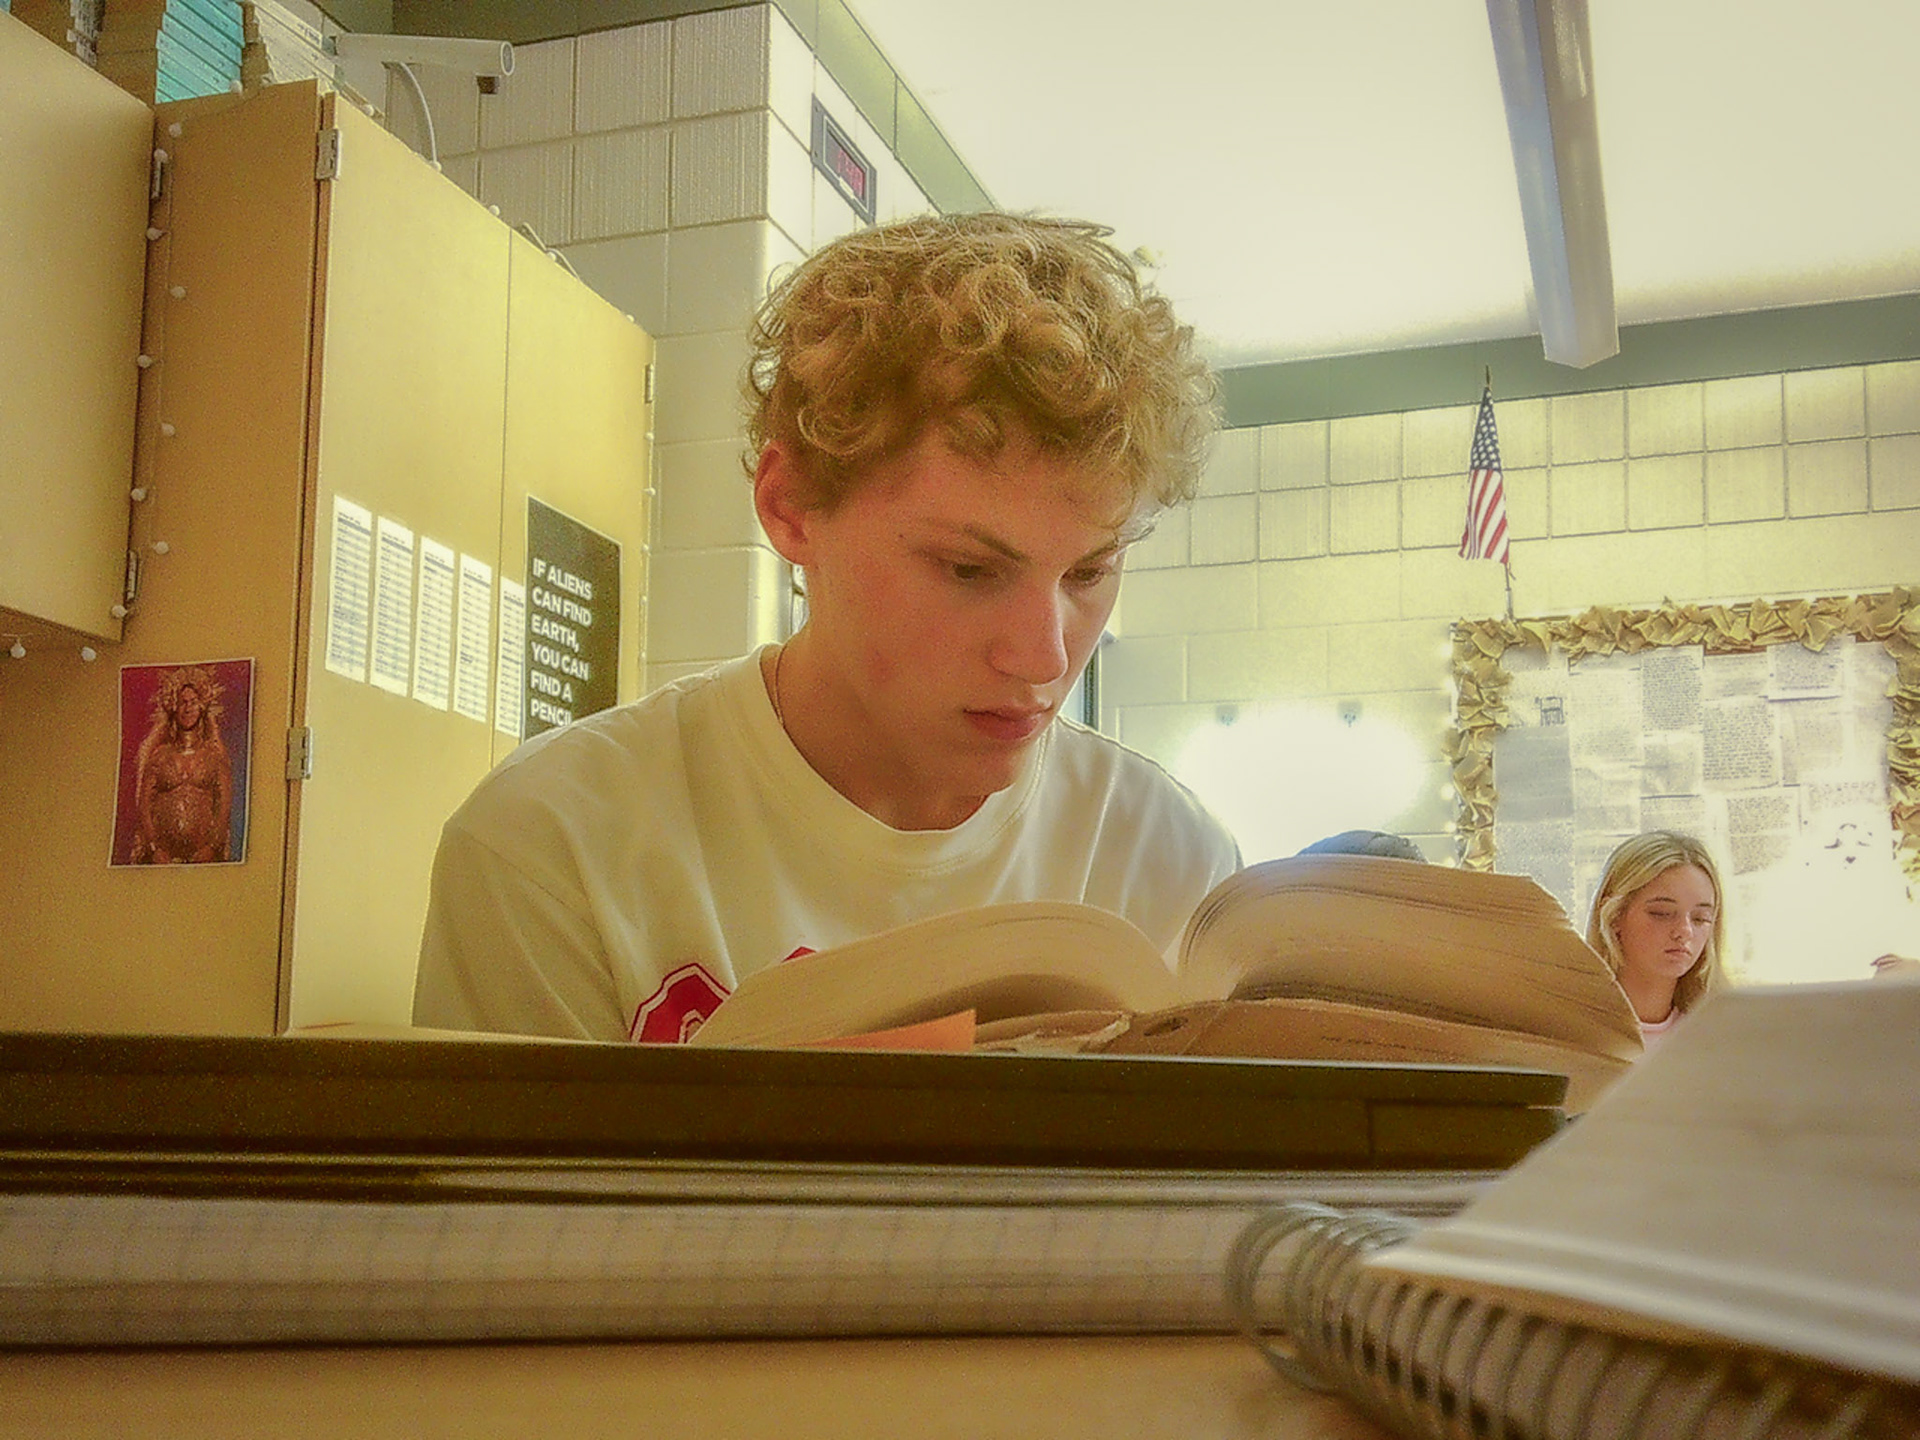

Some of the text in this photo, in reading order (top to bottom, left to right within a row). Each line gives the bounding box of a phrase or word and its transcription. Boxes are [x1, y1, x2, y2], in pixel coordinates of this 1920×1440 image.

[533, 557, 592, 600] IF ALIENS
[532, 586, 592, 627] CAN FIND
[531, 614, 579, 653] EARTH,
[531, 641, 589, 681] YOU CAN
[530, 669, 573, 703] FIND A
